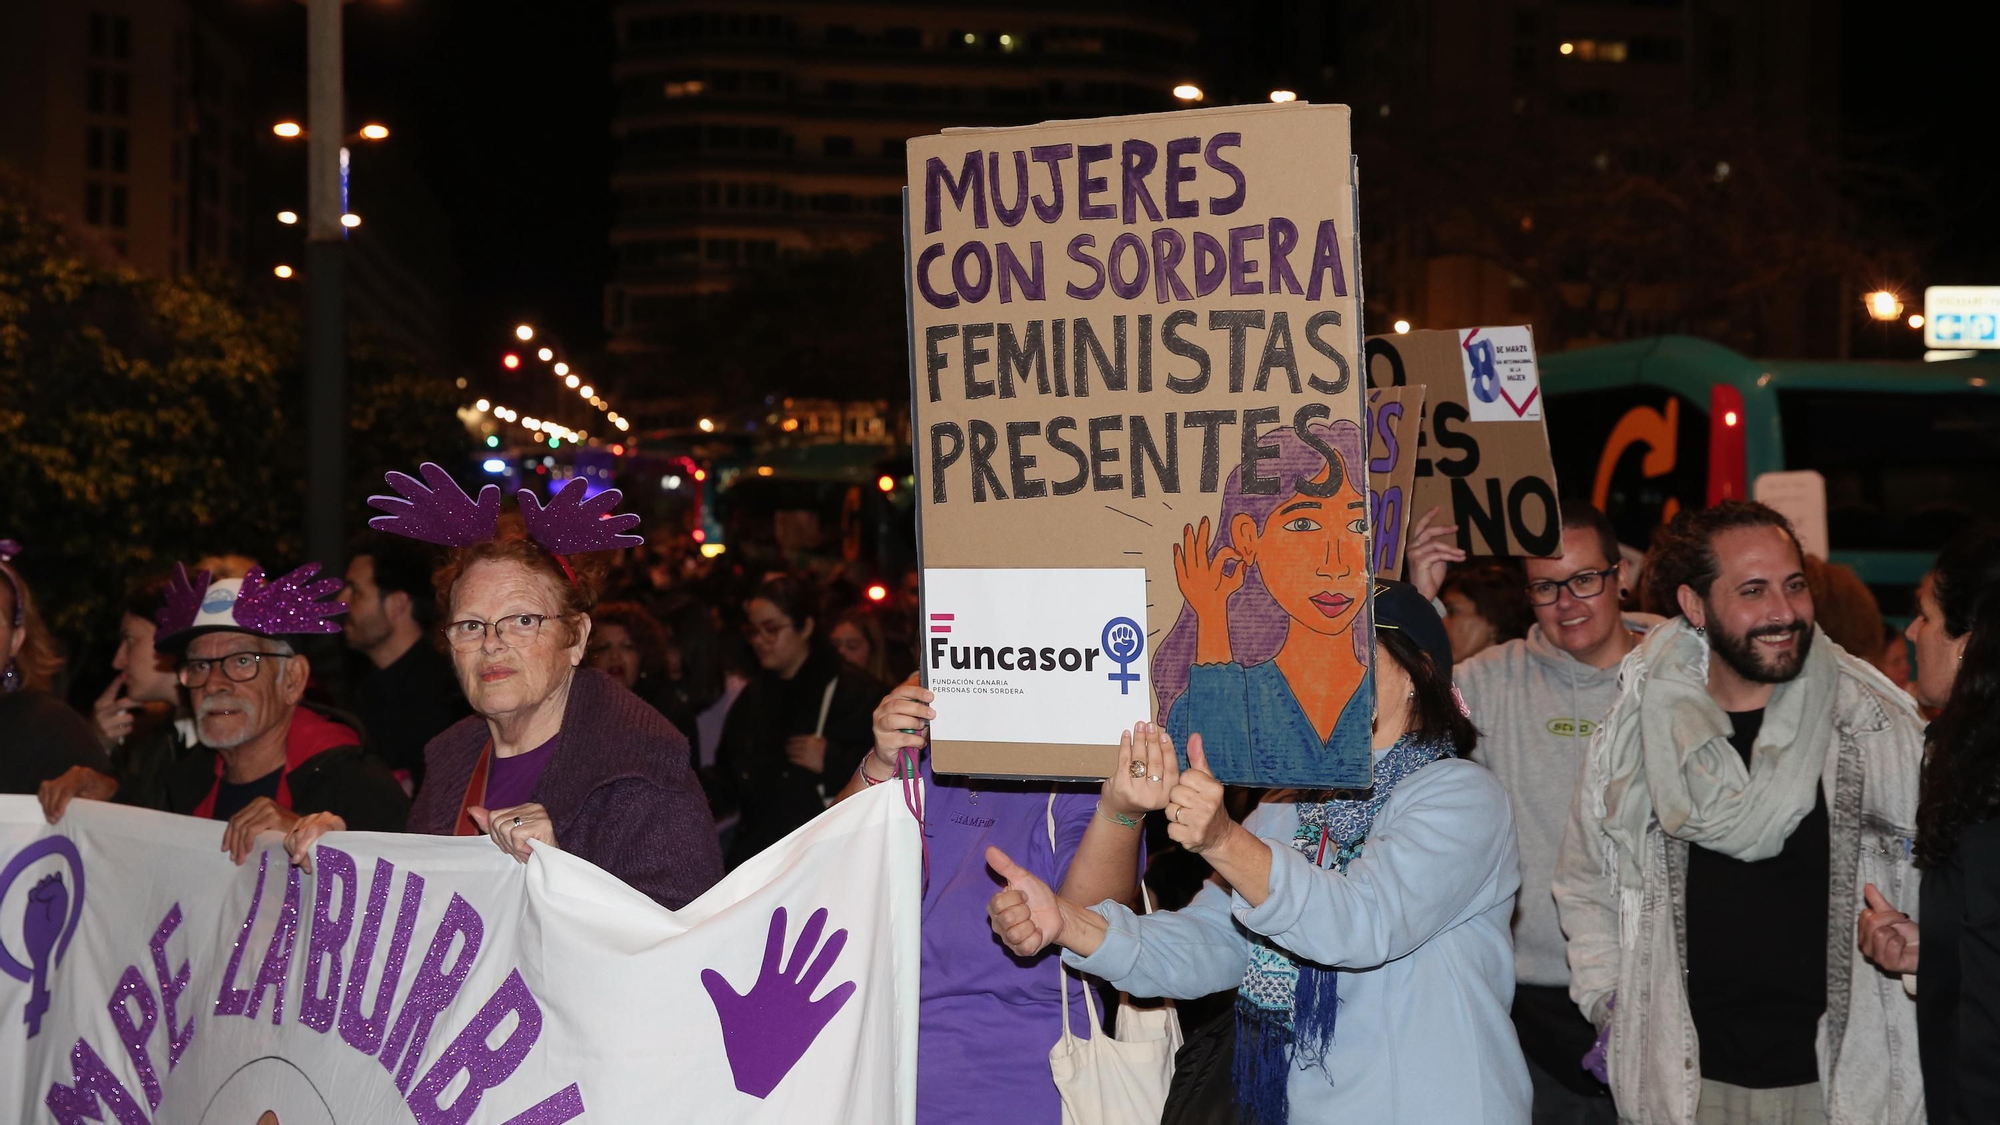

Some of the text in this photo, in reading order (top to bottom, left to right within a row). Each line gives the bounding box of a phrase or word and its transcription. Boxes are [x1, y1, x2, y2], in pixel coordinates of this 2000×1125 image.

[924, 131, 1247, 235] MUJERES
[916, 217, 1348, 309] CON SORDERA
[925, 309, 1350, 402] FEMINISTAS
[930, 403, 1344, 504] PRESENTES
[1451, 475, 1561, 557] NO
[930, 637, 1100, 671] Funcasor
[933, 686, 971, 694] PERSONAS
[990, 687, 1025, 695] SORDERA
